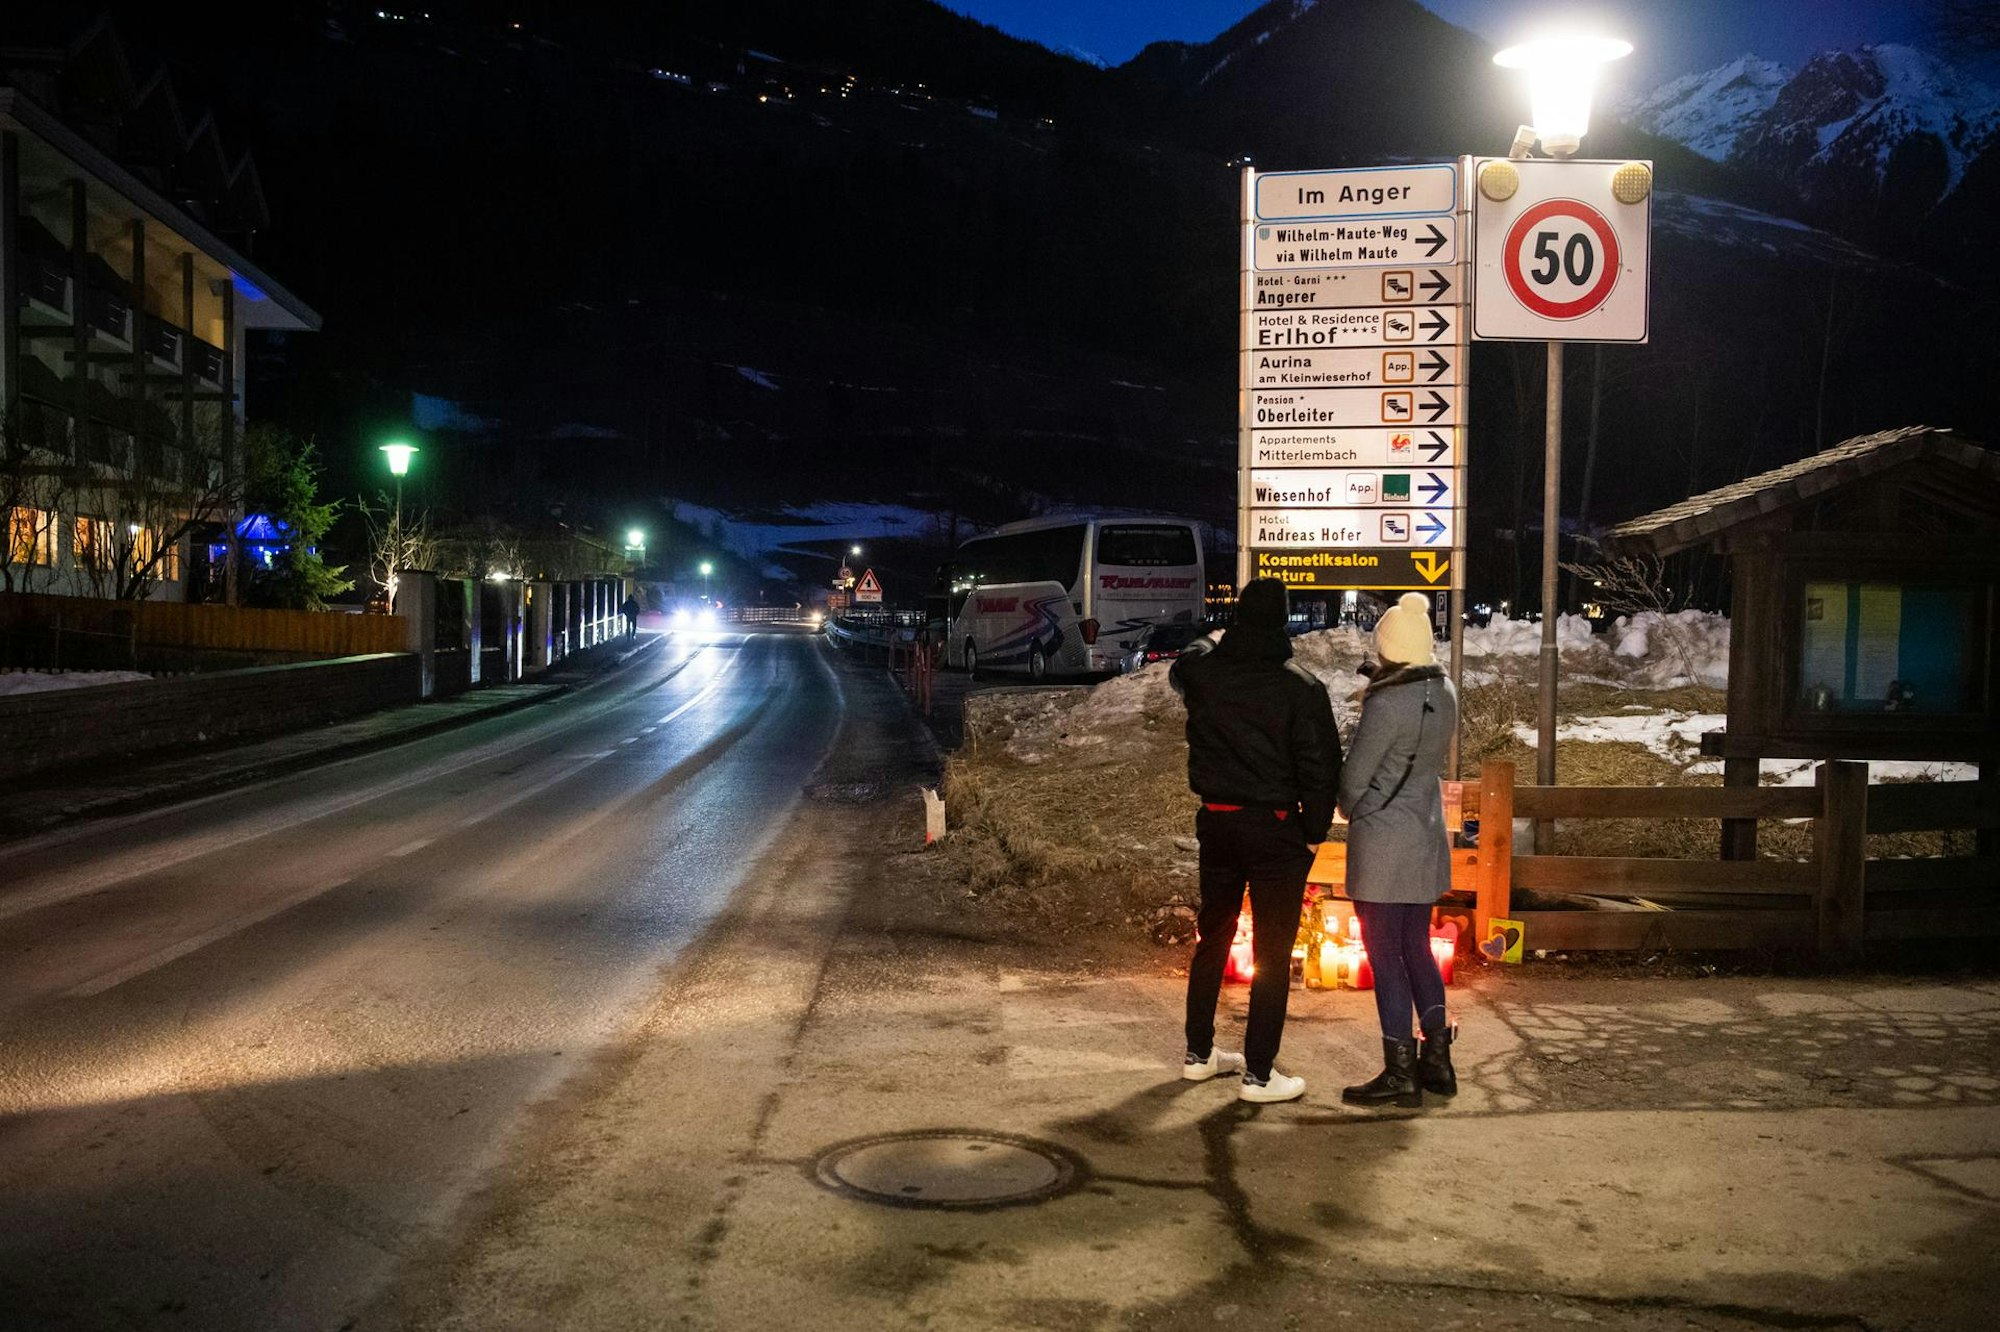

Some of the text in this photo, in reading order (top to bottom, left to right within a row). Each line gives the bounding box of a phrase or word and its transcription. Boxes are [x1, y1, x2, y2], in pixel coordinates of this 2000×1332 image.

[1298, 185, 1411, 204] Im Anger
[1277, 227, 1407, 243] Wilhelm-Maute-Weg
[1276, 247, 1398, 262] via Wilhelm Maute
[1531, 232, 1594, 286] 50
[1257, 277, 1283, 286] Hotel
[1294, 276, 1320, 285] Garni
[1258, 291, 1316, 307] Angerer
[1259, 314, 1379, 326] Hotel & Residence
[1259, 327, 1338, 345] Erlhof
[1260, 357, 1311, 368] Aurina
[1388, 362, 1410, 371] App.
[1259, 372, 1371, 383] am Kleinwieserhof
[1257, 396, 1294, 405] Pension
[1258, 408, 1334, 422] Oberleiter
[1260, 435, 1336, 445] Appartements
[1259, 450, 1357, 460] Mitterlembach
[1256, 487, 1332, 502] Wiesenhof
[1350, 484, 1374, 493] App.
[1259, 516, 1289, 525] Hotel
[1259, 527, 1361, 541] Andreas Hofer
[1259, 553, 1378, 566] Kosmetiksalon
